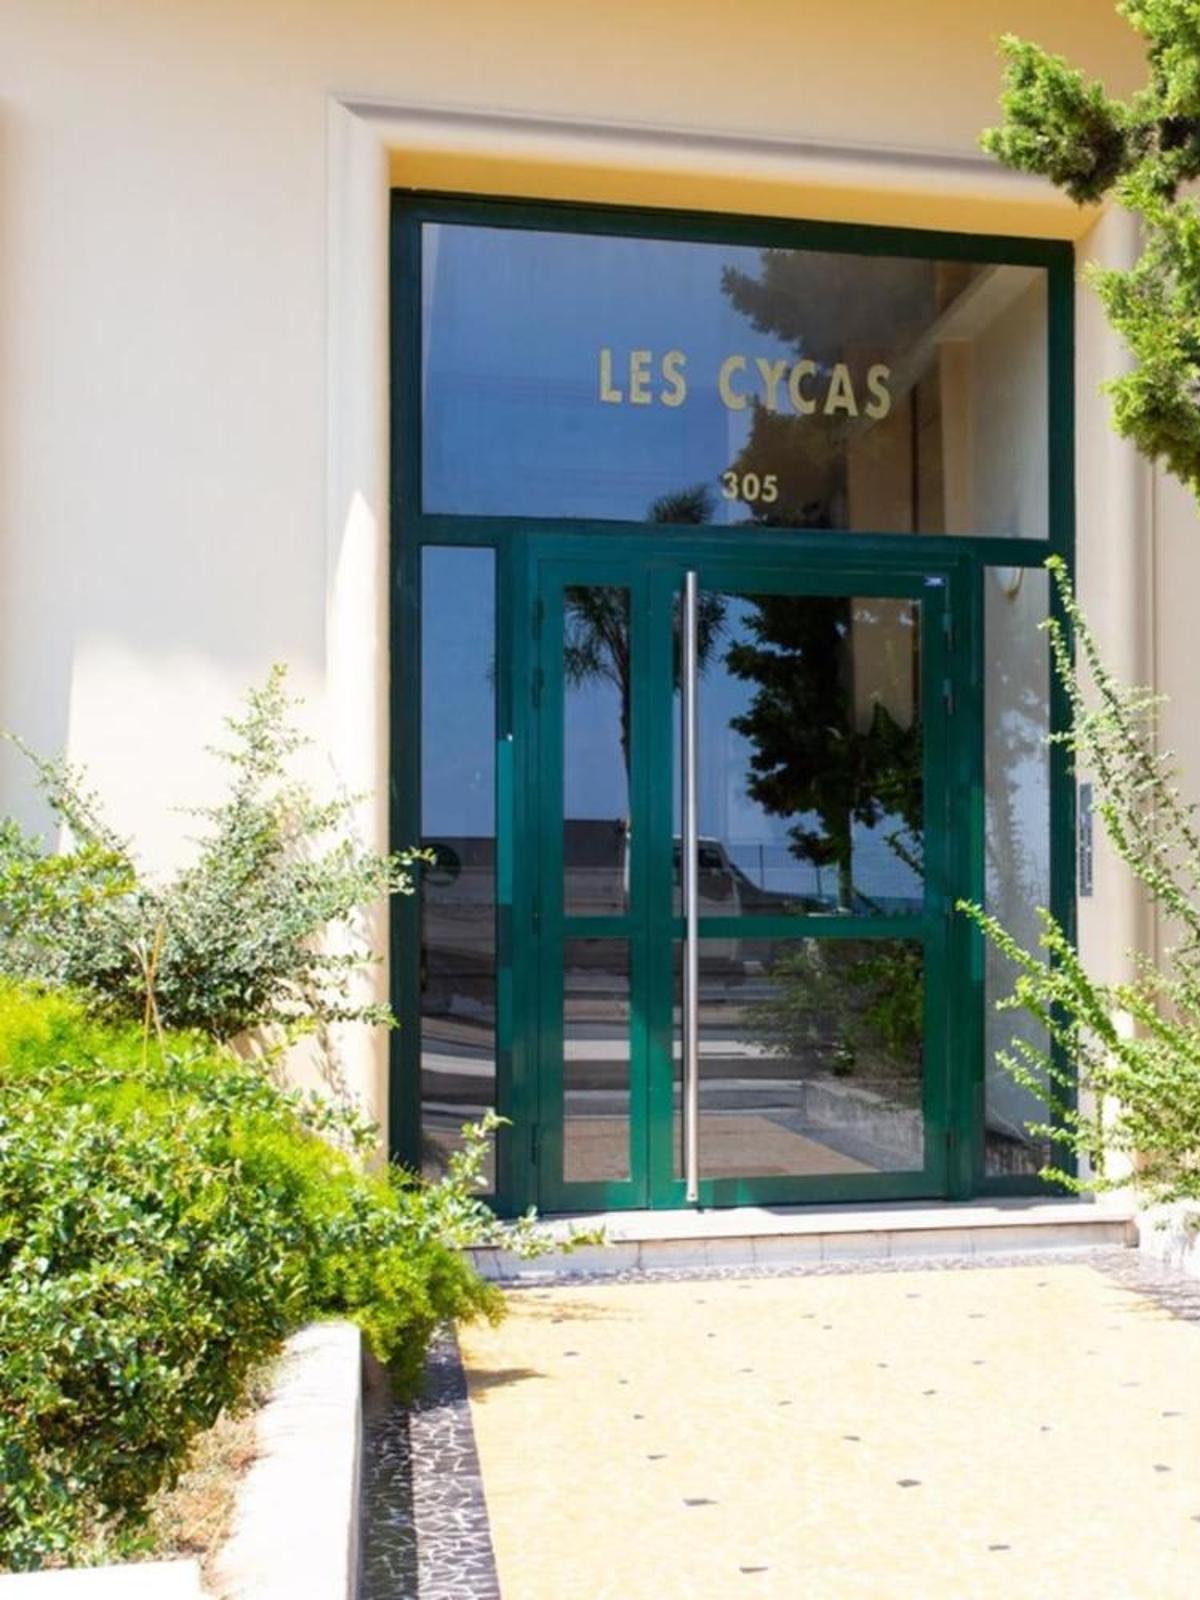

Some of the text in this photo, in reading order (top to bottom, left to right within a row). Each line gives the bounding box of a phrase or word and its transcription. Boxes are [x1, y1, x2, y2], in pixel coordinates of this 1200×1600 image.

[600, 348, 892, 419] LES CYCAS
[722, 471, 779, 503] 305
